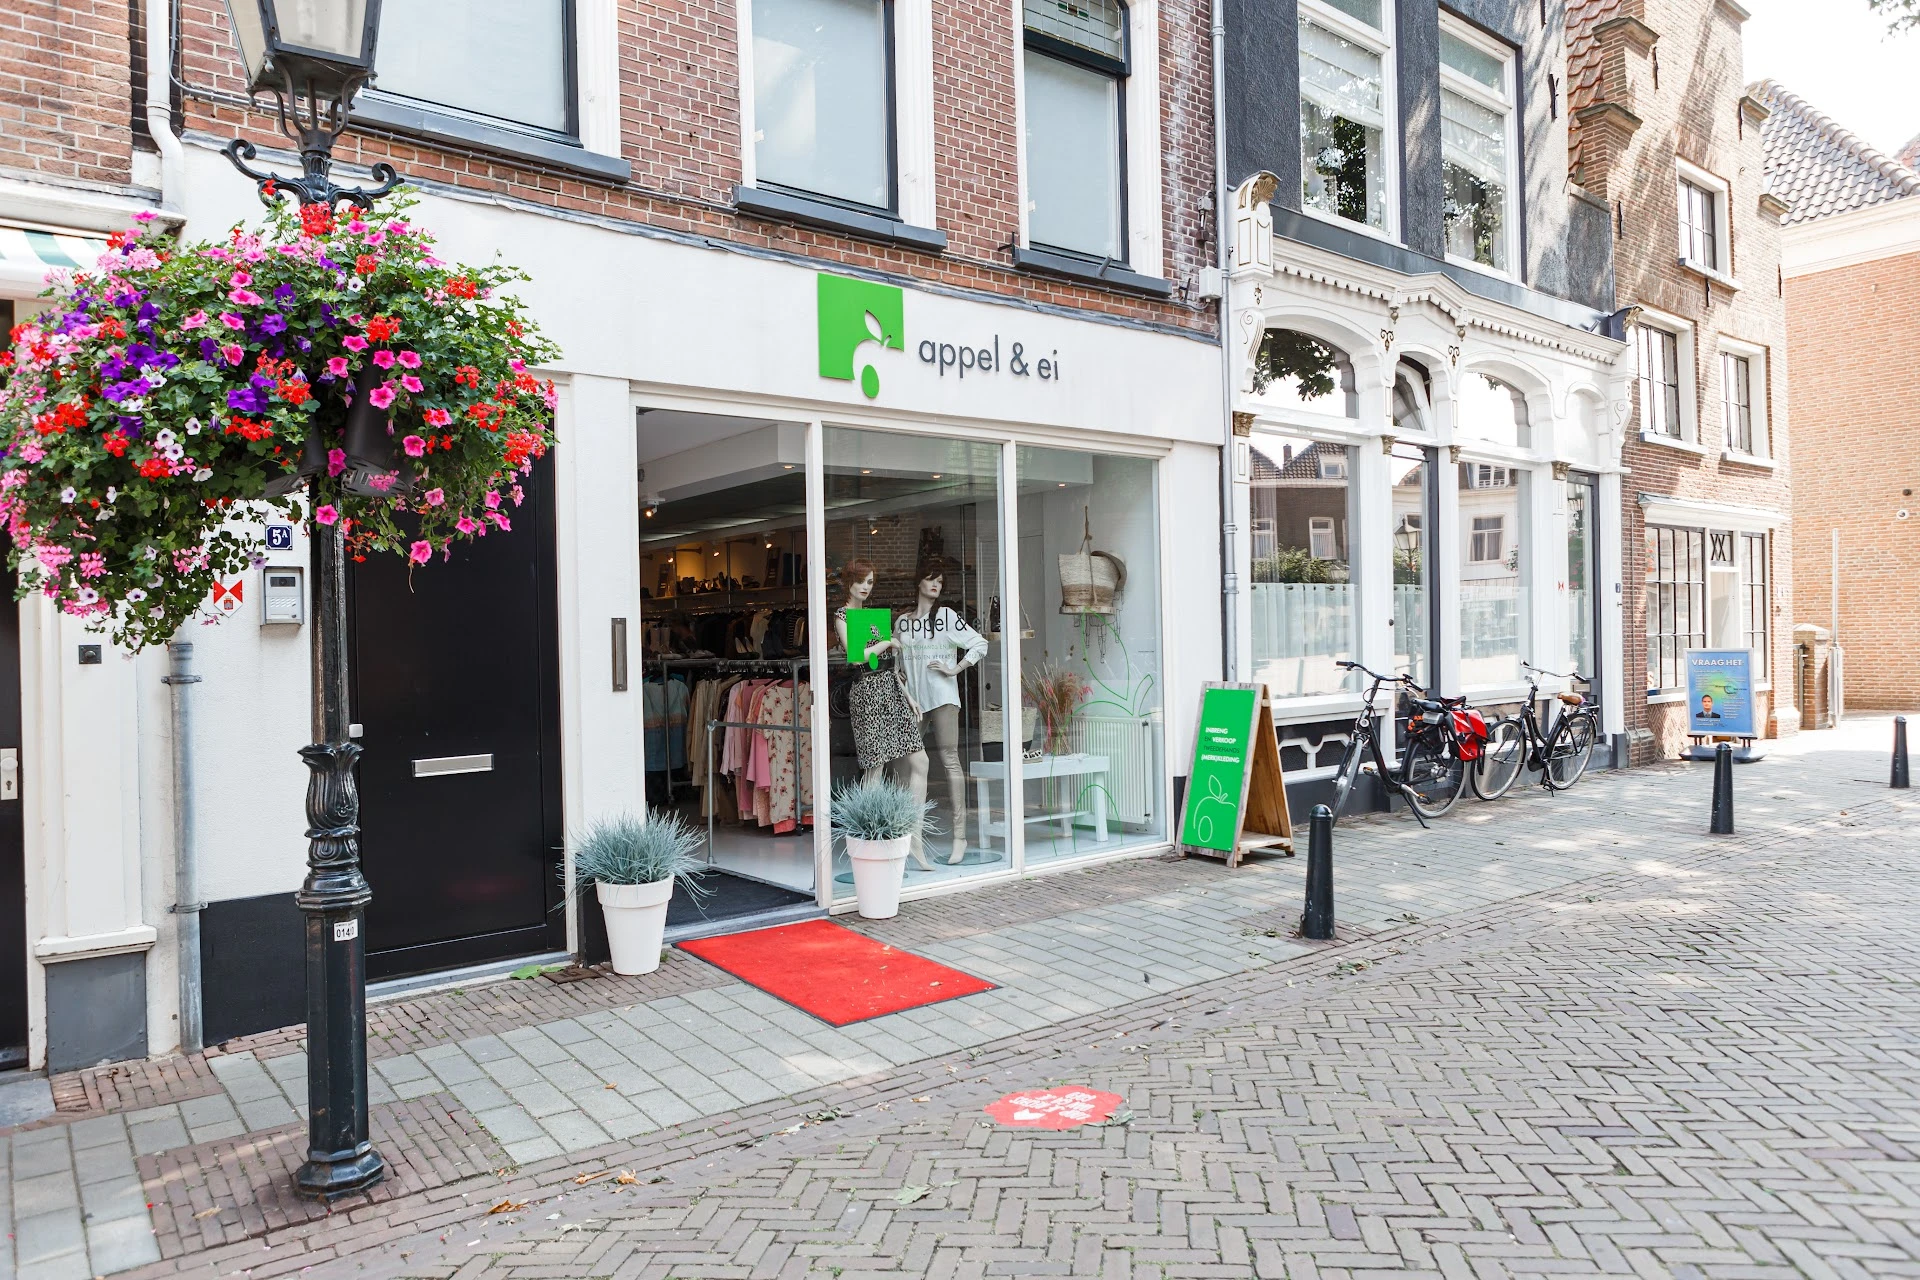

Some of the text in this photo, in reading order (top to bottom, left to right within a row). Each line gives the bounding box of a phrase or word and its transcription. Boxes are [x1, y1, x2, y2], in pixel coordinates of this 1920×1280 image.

[919, 334, 1059, 381] appel & ei
[272, 528, 288, 546] 5A
[899, 608, 949, 639] appel
[954, 611, 967, 632] &
[1205, 727, 1229, 735] INBRENG
[1212, 736, 1237, 744] VERKOOP
